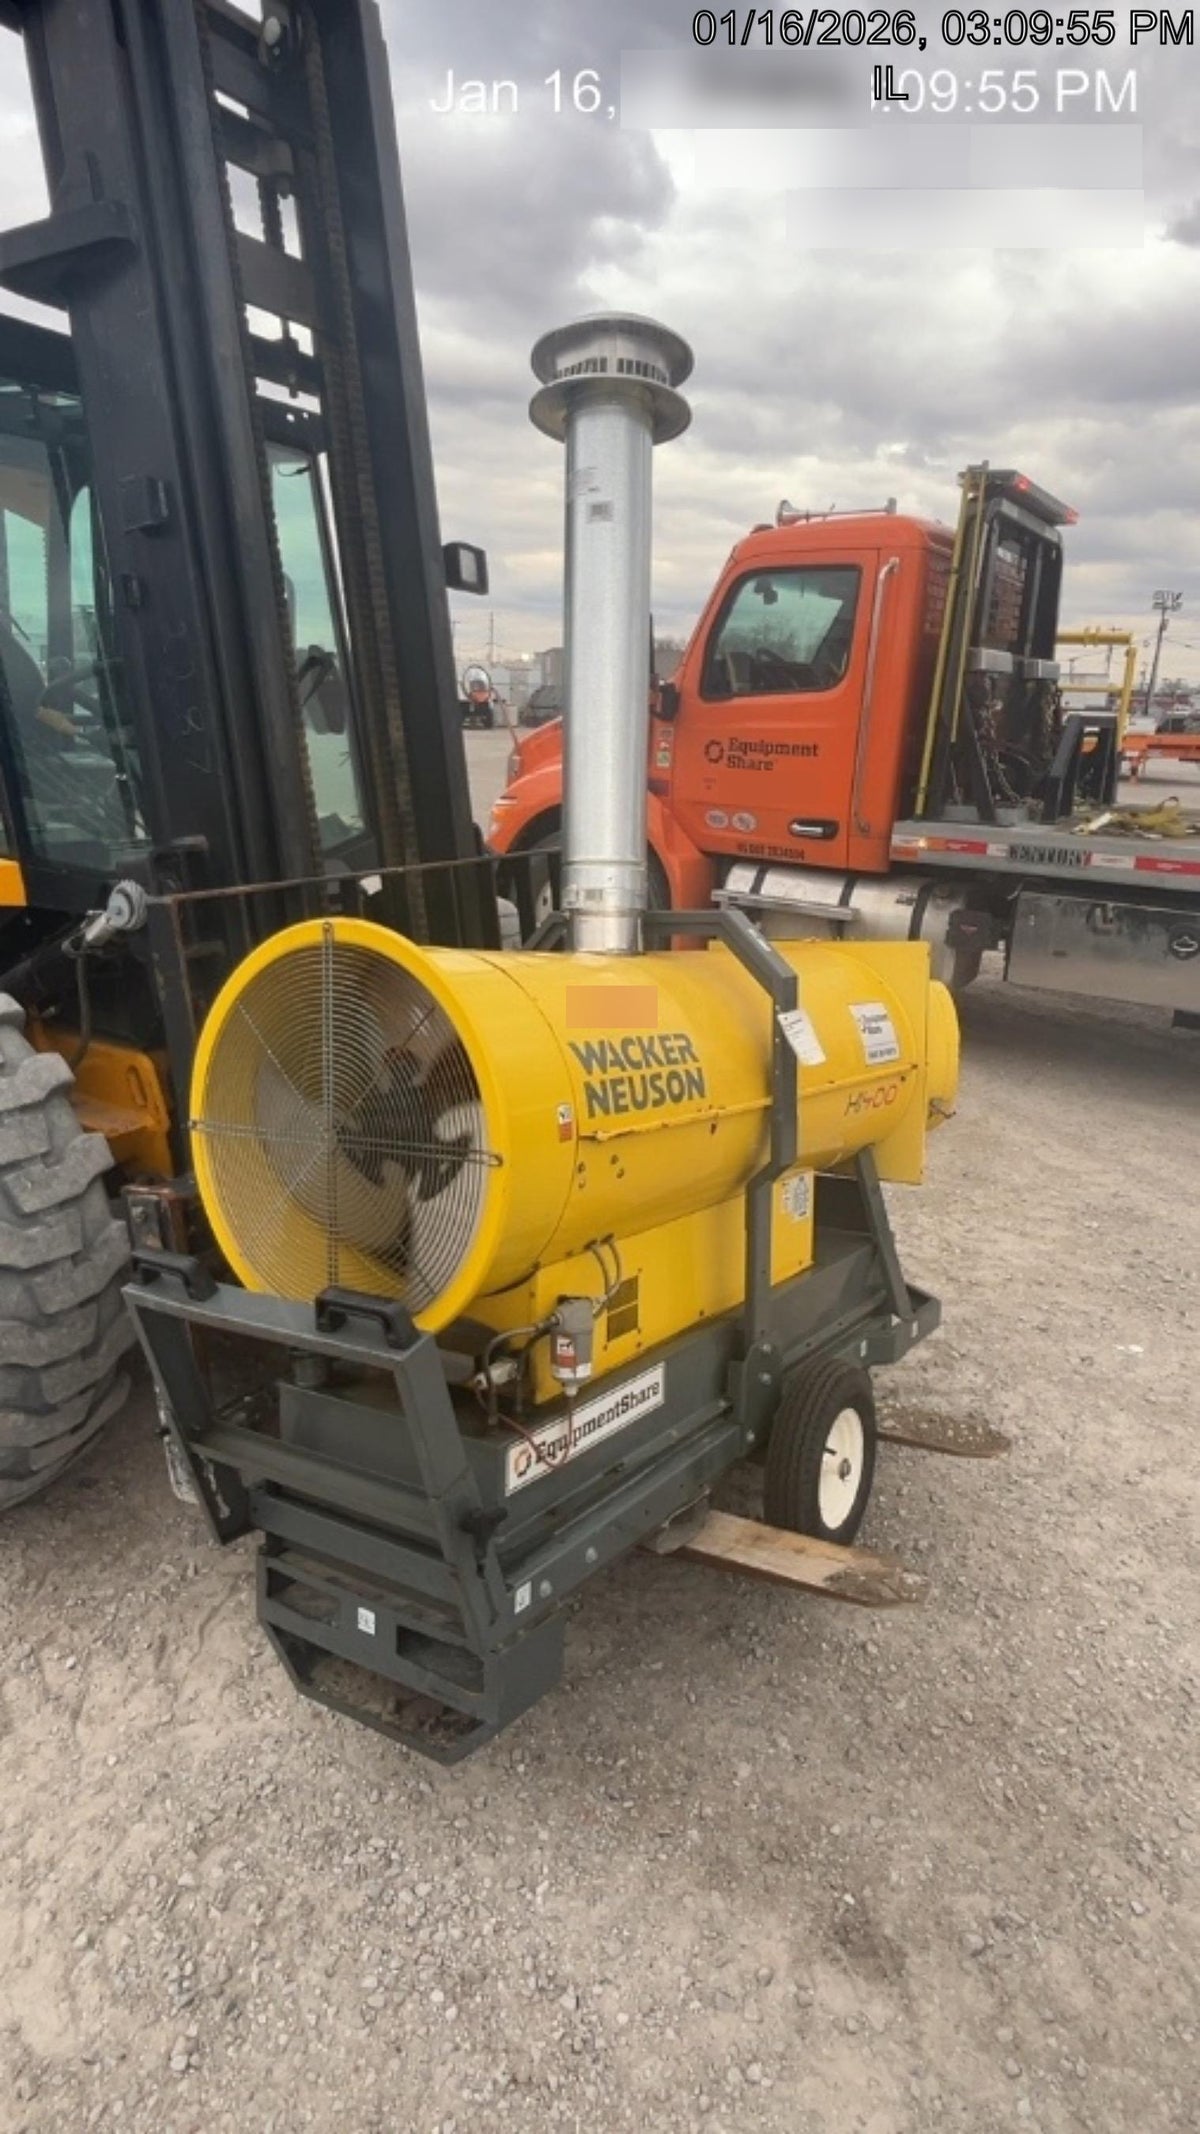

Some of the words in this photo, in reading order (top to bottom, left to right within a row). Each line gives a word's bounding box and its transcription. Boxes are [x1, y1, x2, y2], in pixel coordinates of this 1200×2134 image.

[726, 754, 774, 771] Share
[727, 737, 819, 758] Equipment
[568, 1033, 700, 1076] WACKER
[583, 1067, 706, 1118] NEUSON
